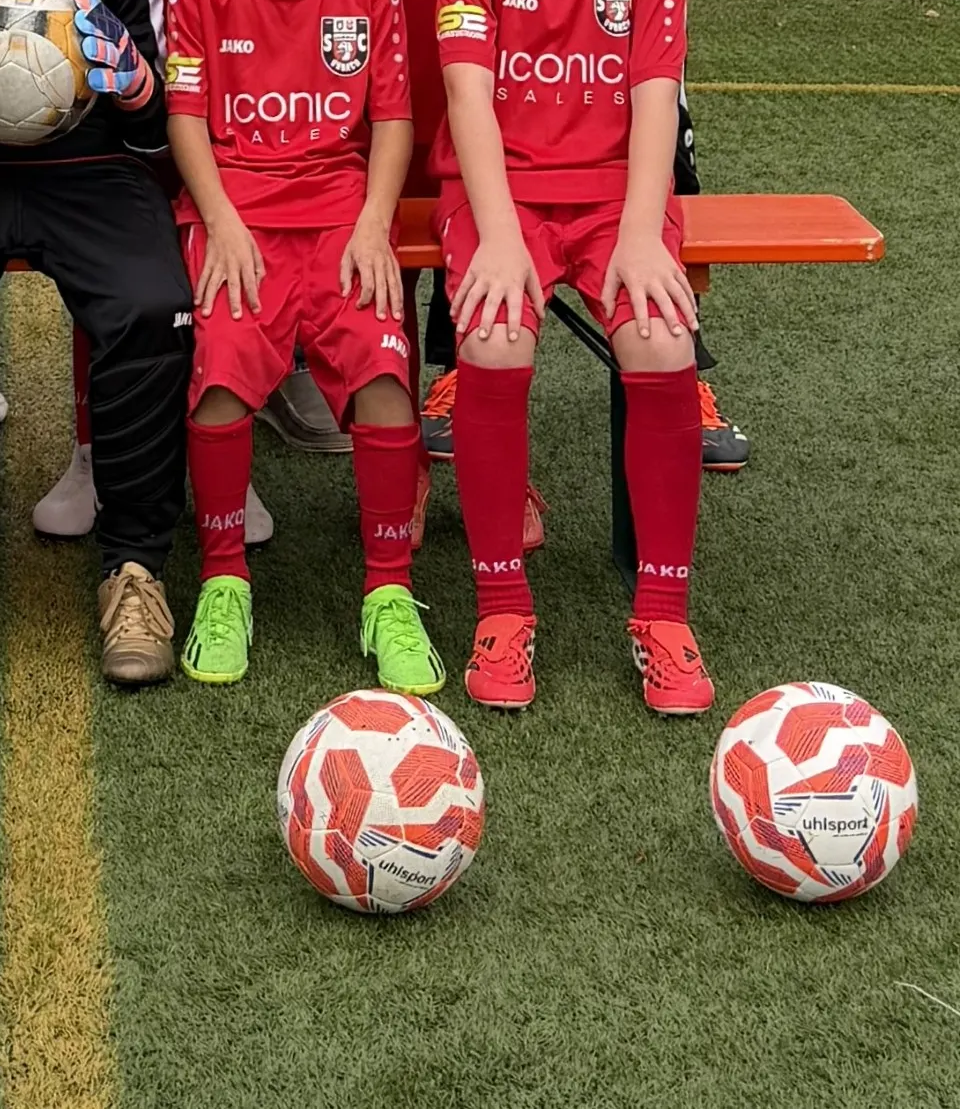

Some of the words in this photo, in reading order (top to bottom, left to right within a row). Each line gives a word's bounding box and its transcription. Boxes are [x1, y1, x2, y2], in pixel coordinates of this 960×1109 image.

[219, 39, 254, 54] JAKO
[496, 88, 625, 105] SALES
[173, 312, 192, 328] JAK
[201, 508, 244, 531] JAKO
[637, 560, 689, 578] JAKO
[802, 816, 869, 832] uhlsport
[378, 859, 437, 886] uhlsport
